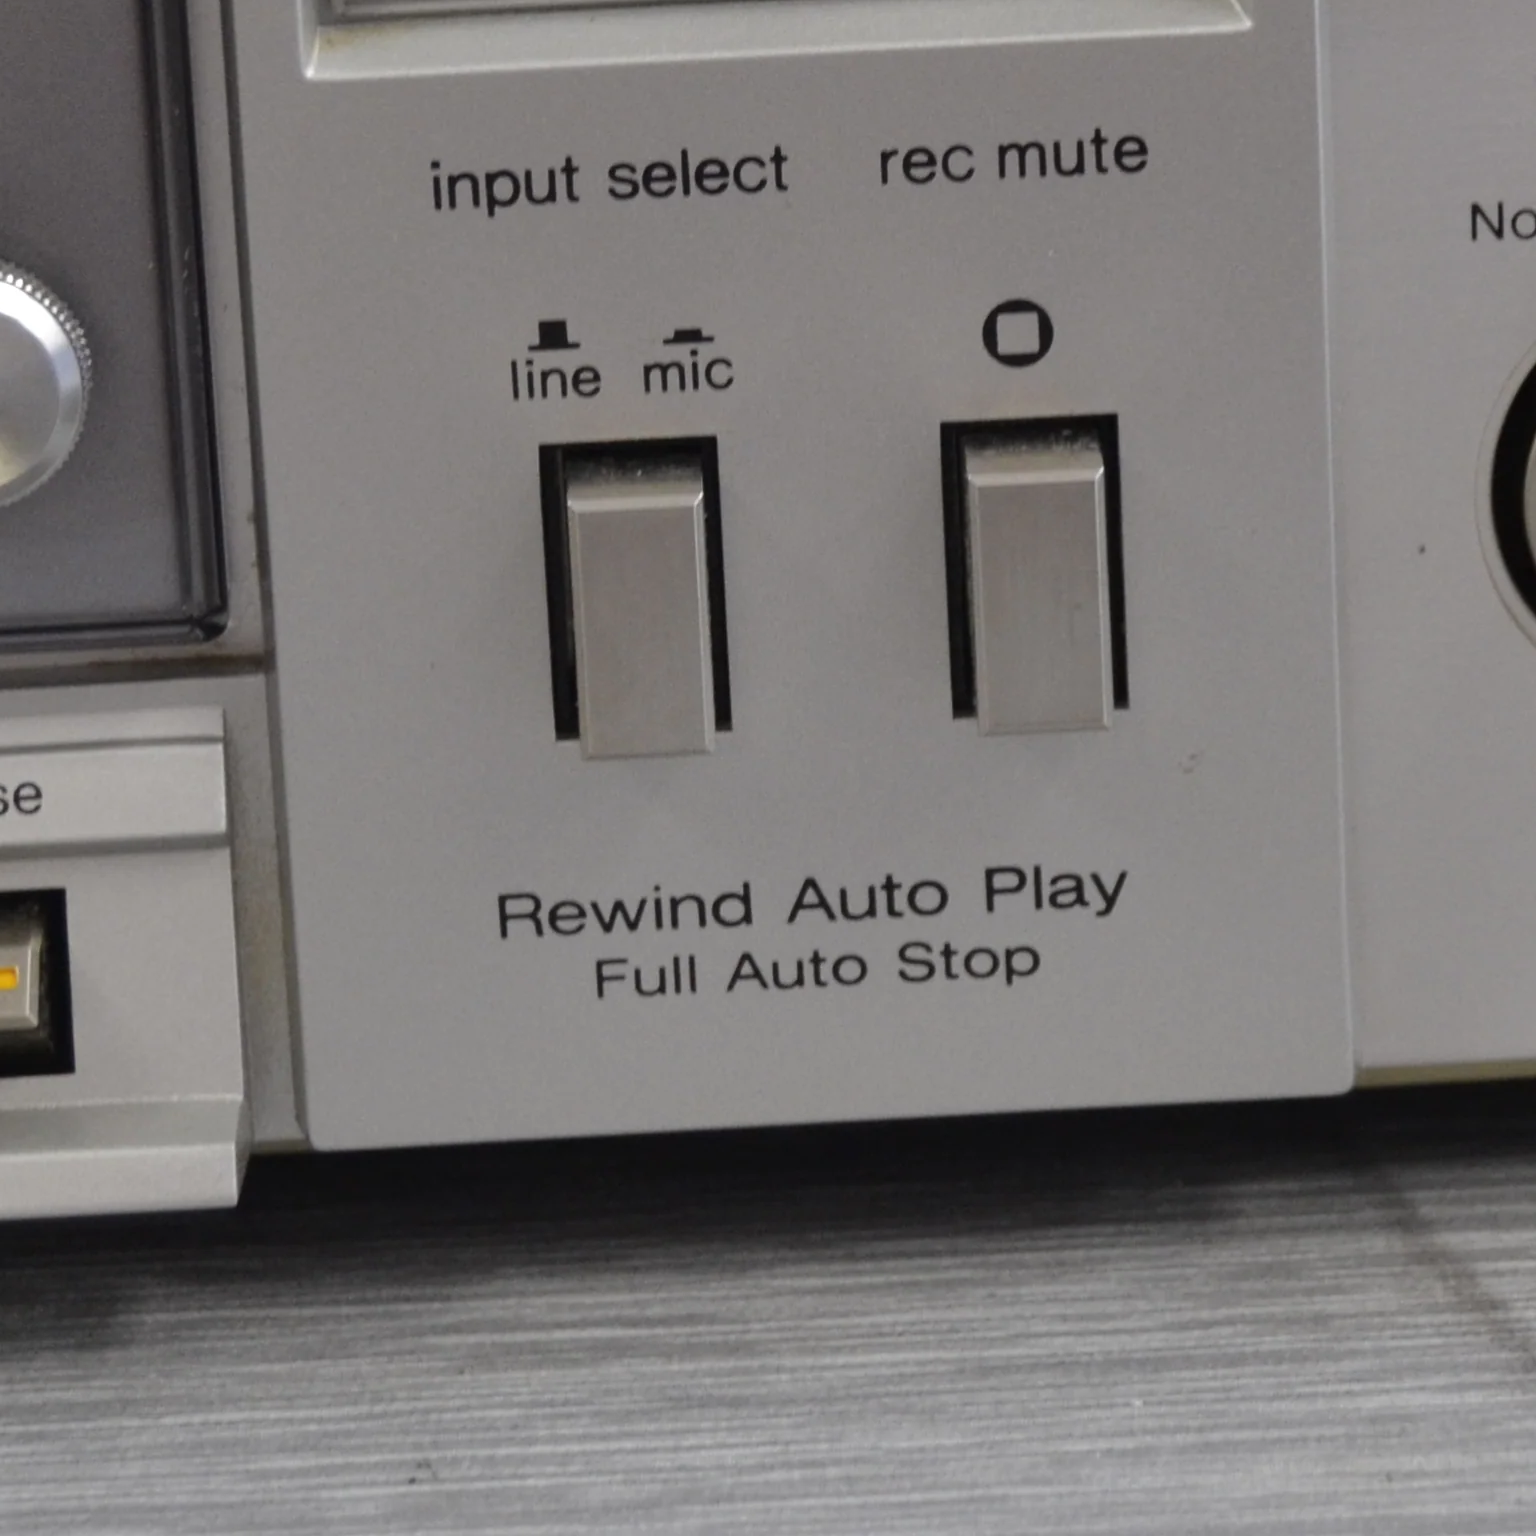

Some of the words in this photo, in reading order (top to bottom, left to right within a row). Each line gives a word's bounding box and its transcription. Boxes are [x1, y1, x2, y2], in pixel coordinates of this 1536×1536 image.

[429, 154, 581, 219] input
[606, 144, 789, 202] select
[879, 143, 976, 186] rec
[996, 126, 1150, 180] mute
[509, 358, 603, 402] line
[642, 347, 735, 395] mic
[496, 880, 754, 941] Rewind
[786, 873, 950, 925] Auto
[983, 864, 1128, 918] Play
[594, 953, 698, 1000] Full
[725, 948, 869, 993] Auto
[896, 940, 1042, 987] Stop
